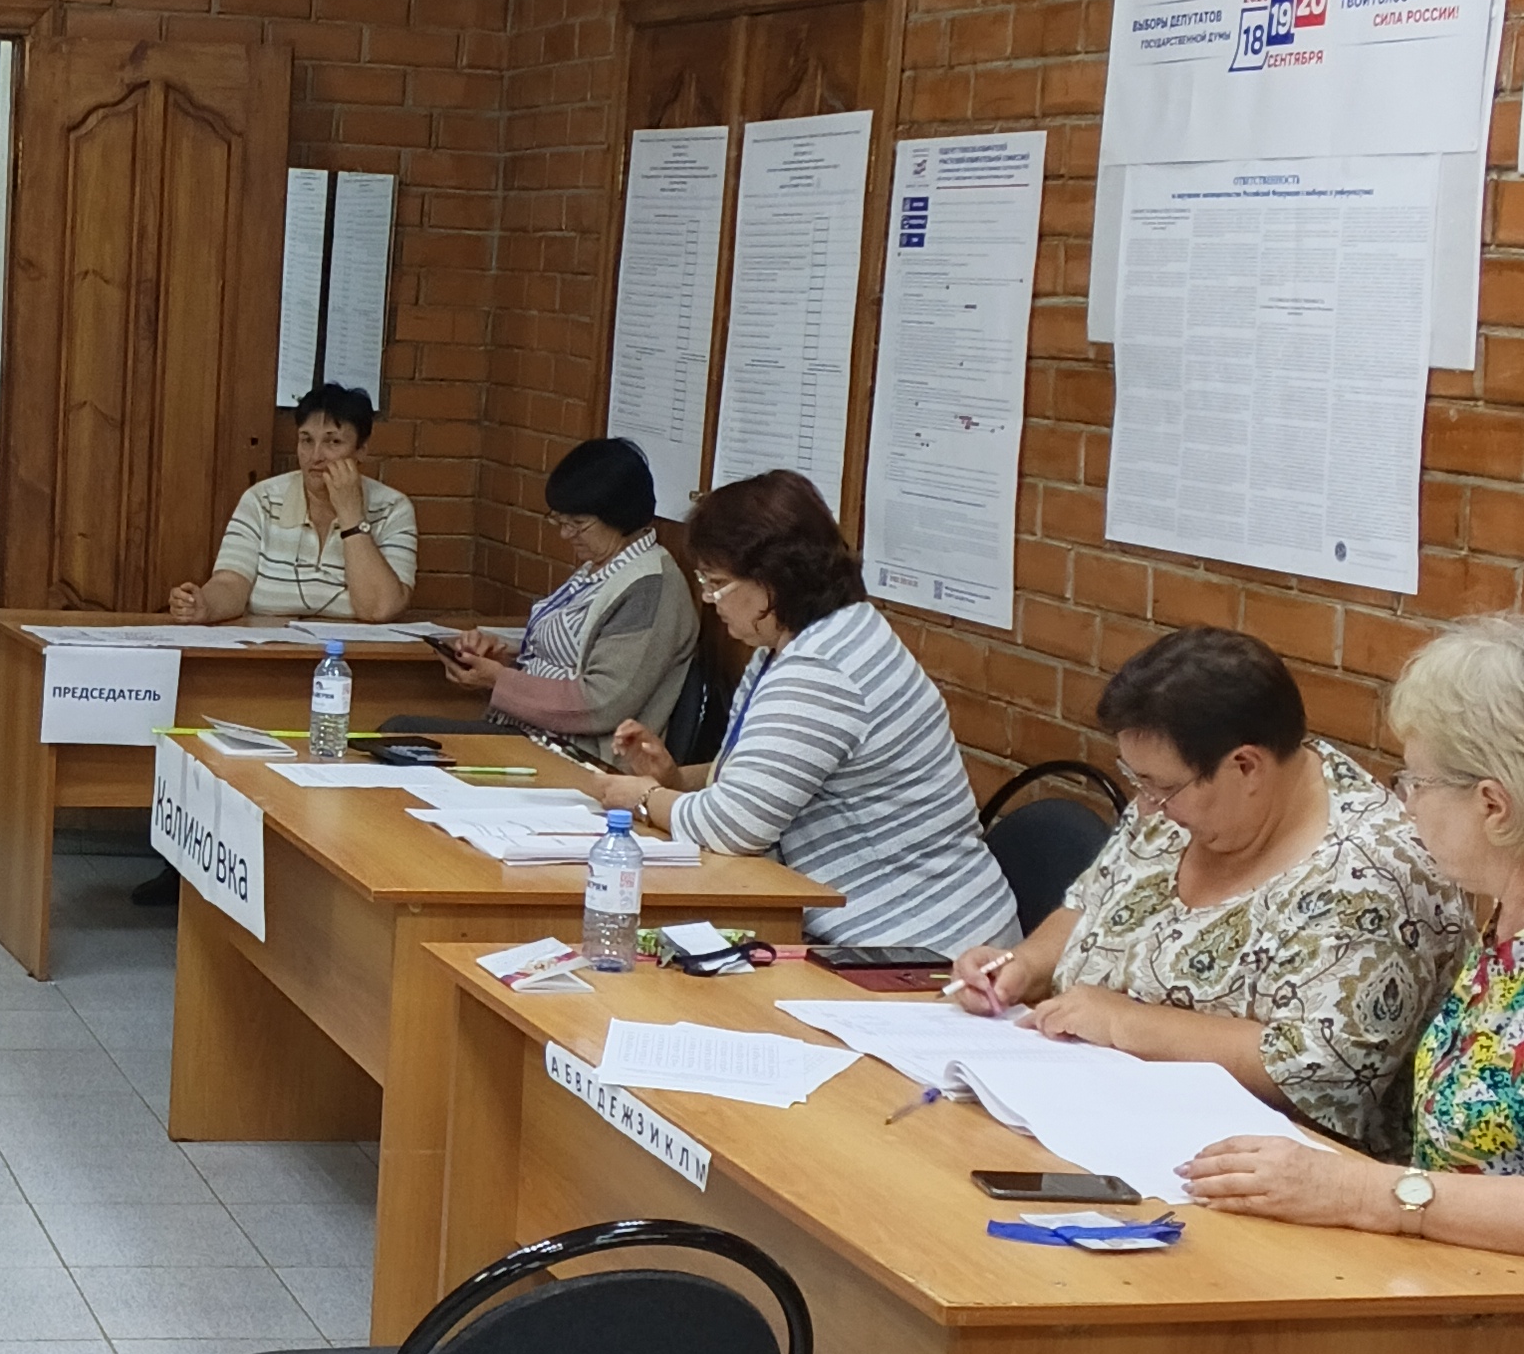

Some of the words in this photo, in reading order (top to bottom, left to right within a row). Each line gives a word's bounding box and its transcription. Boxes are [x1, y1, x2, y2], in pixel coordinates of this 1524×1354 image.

[1132, 17, 1168, 32] ВЫБОРЫ
[1169, 10, 1222, 30] ДЕПУТАТОВ
[1270, 1, 1292, 37] 19
[1373, 11, 1403, 27] СИЛА
[1405, 5, 1460, 24] РОССИИ!
[1141, 31, 1206, 50] ГОСУДАРСТВЕННОЙ
[1207, 30, 1231, 44] ДУМЫ
[1243, 24, 1265, 56] 18
[1268, 50, 1324, 68] СЕНТЯБРЯ
[52, 686, 161, 702] ПРЕДСЕДАТЕЛЬ
